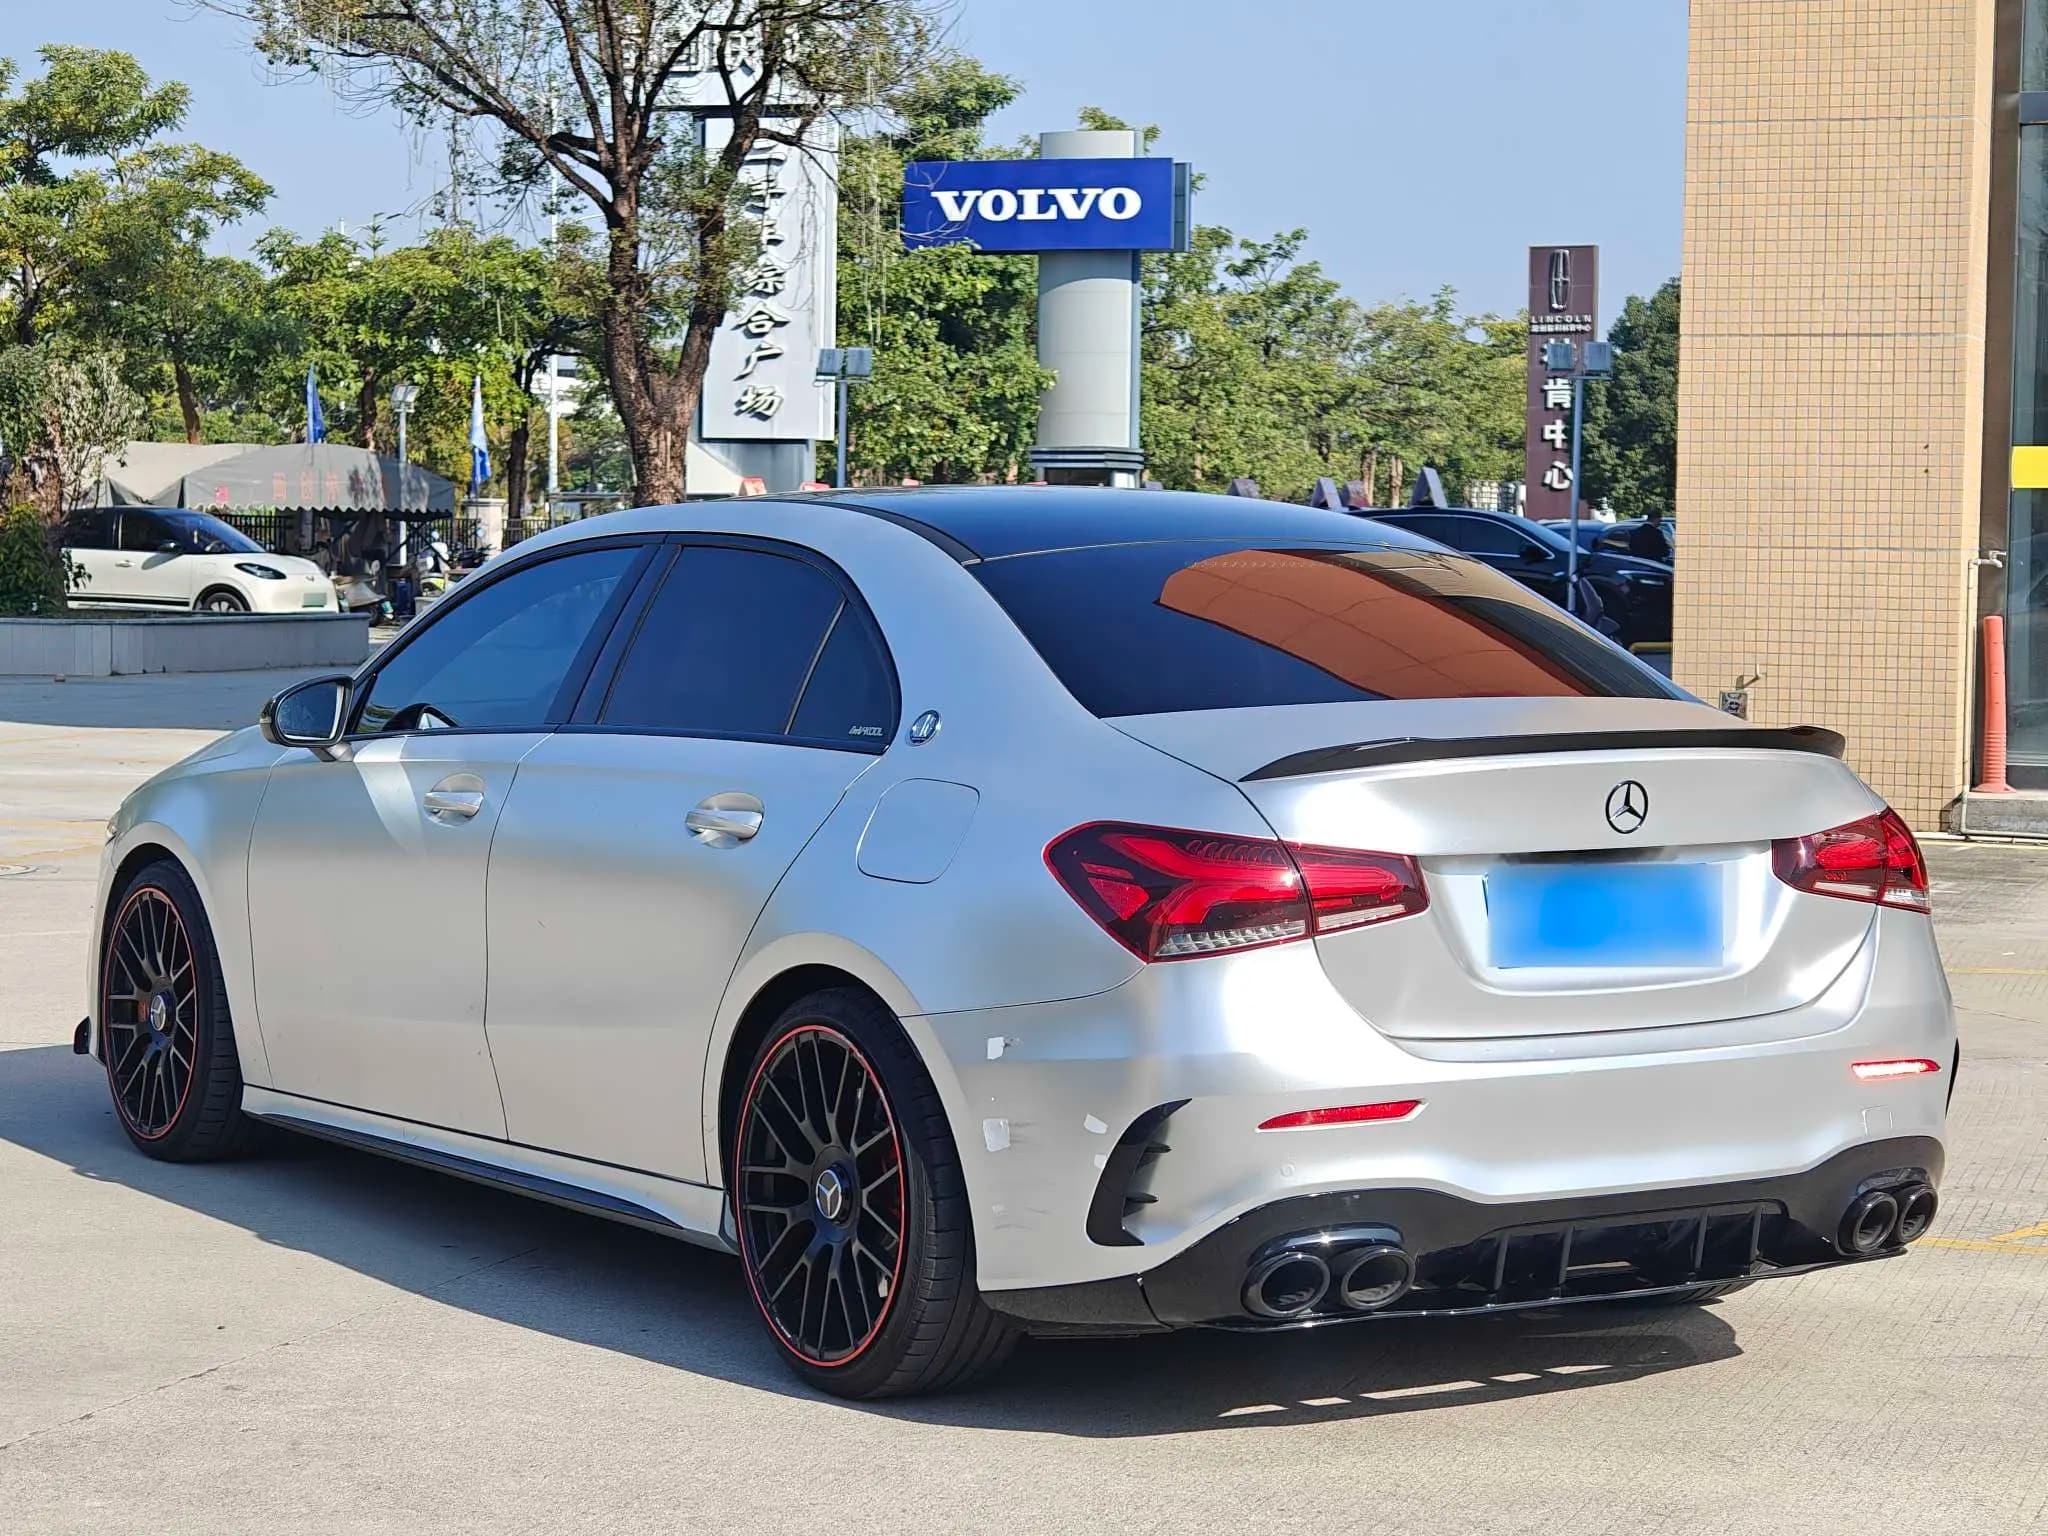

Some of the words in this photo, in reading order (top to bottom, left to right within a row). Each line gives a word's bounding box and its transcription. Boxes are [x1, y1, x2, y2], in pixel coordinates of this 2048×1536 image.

[931, 186, 1142, 222] VOLVO
[1531, 314, 1592, 324] LINCOLN
[1541, 338, 1577, 489] 肯中心
